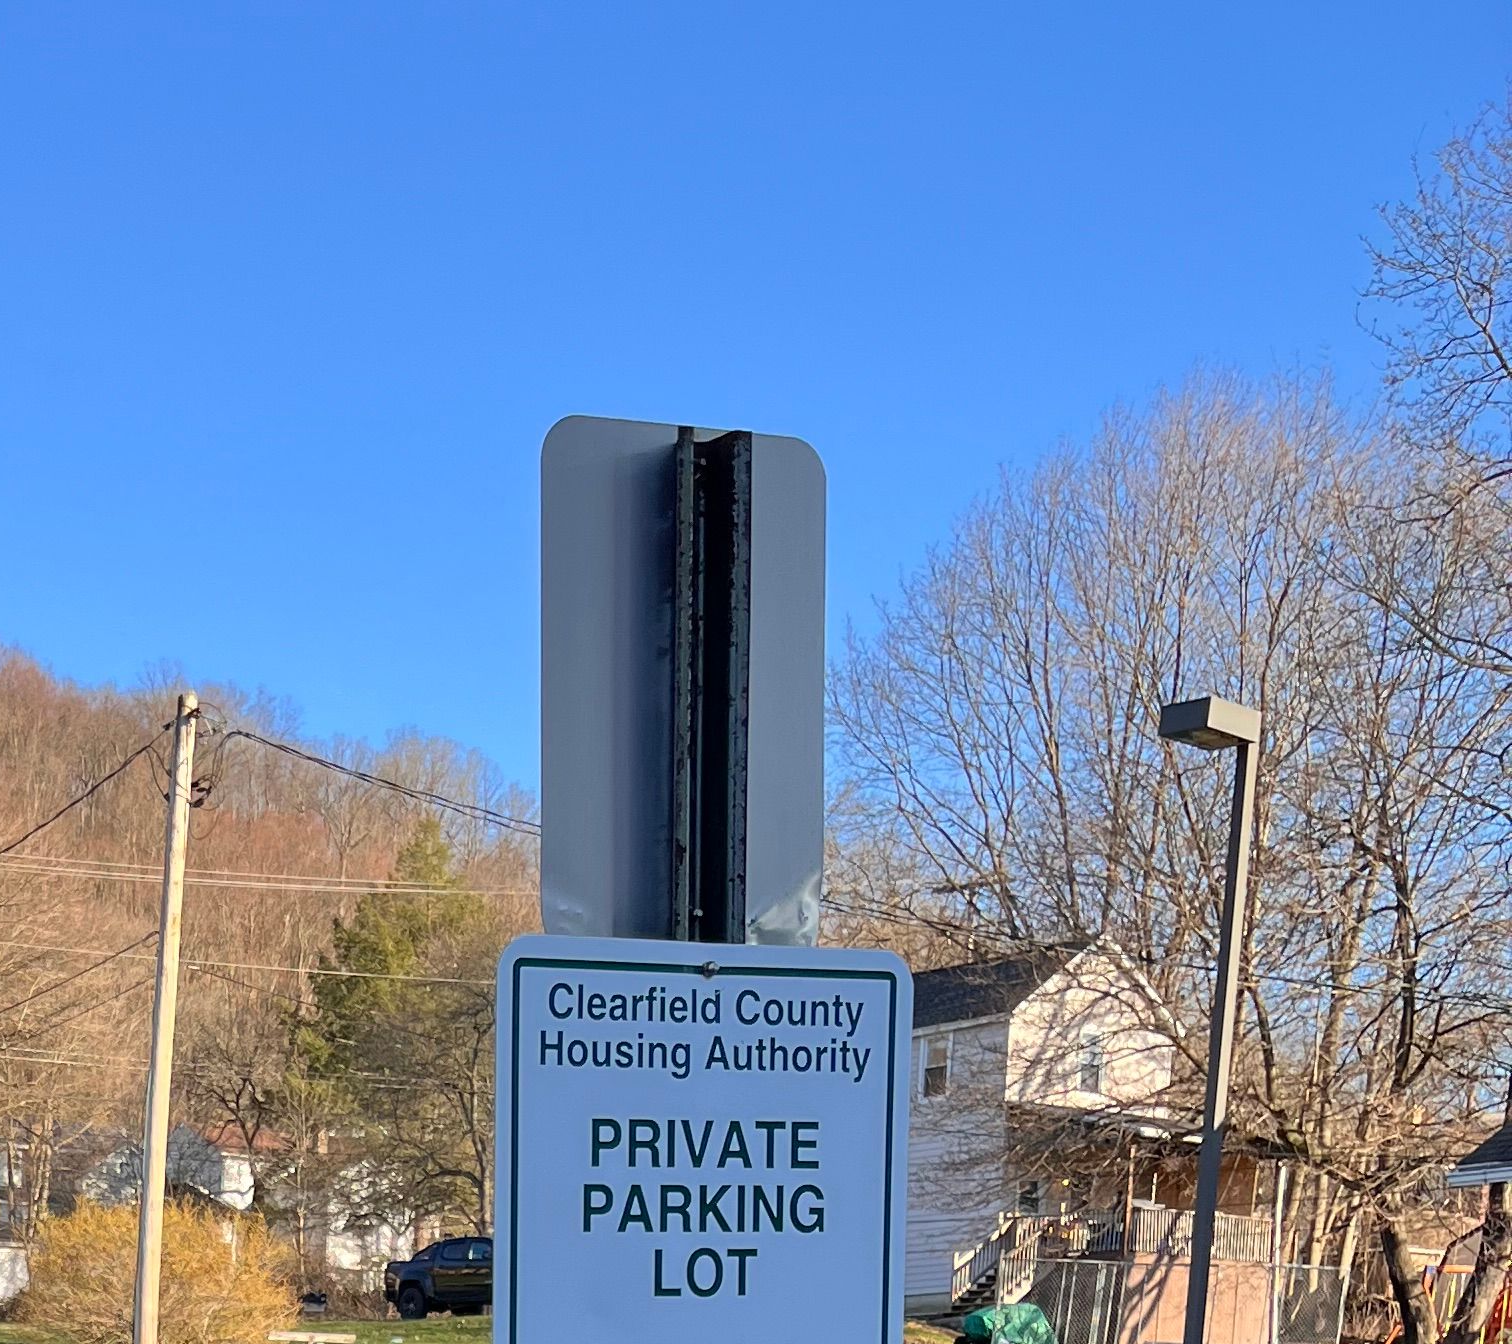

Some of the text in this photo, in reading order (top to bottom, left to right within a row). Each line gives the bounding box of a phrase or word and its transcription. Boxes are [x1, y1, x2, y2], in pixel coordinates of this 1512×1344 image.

[548, 982, 865, 1038] Clearfield County
[539, 1029, 872, 1082] Housing Authority
[591, 1118, 820, 1170] PRIVATE
[582, 1183, 825, 1234] PARKING
[653, 1247, 759, 1298] LOT
